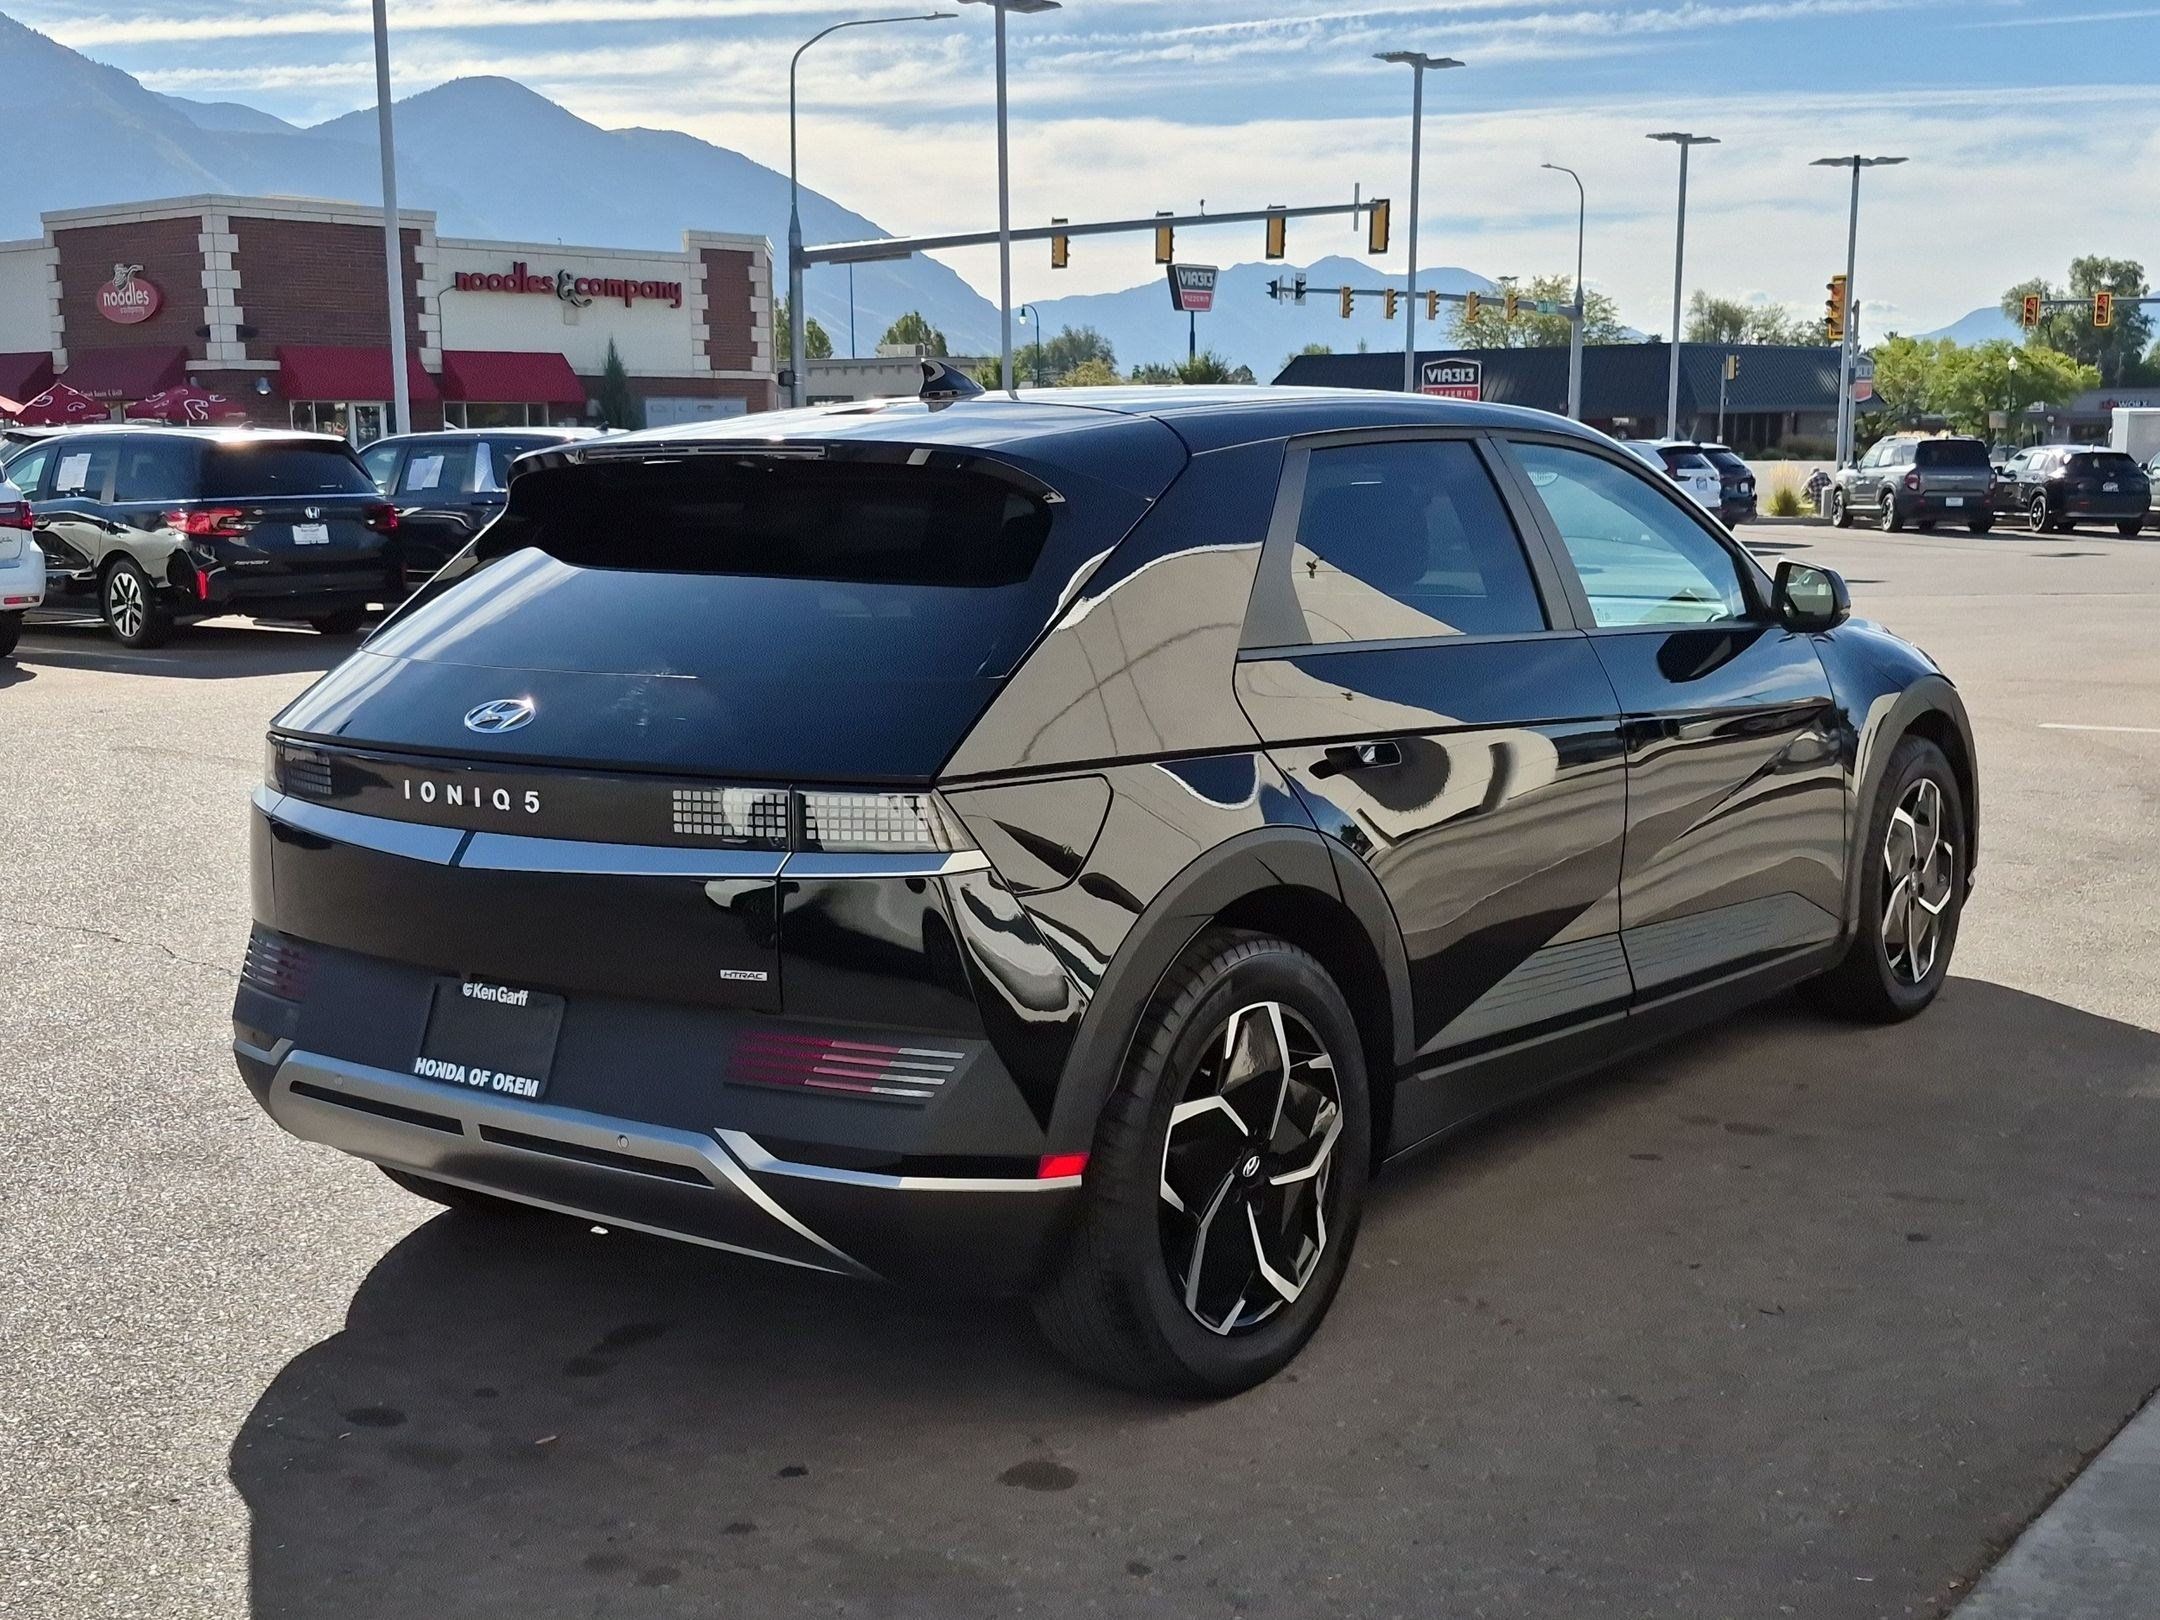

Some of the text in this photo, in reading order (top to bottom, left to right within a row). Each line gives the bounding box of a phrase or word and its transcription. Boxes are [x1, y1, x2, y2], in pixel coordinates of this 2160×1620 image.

[103, 281, 150, 307] noodles
[455, 262, 554, 294] noodles
[574, 277, 682, 308] company
[404, 779, 540, 814] IONIQ 5
[723, 971, 764, 980] HTRAC
[472, 982, 529, 1007] Ken Garff
[414, 1057, 540, 1098] HONDA OF OREM
